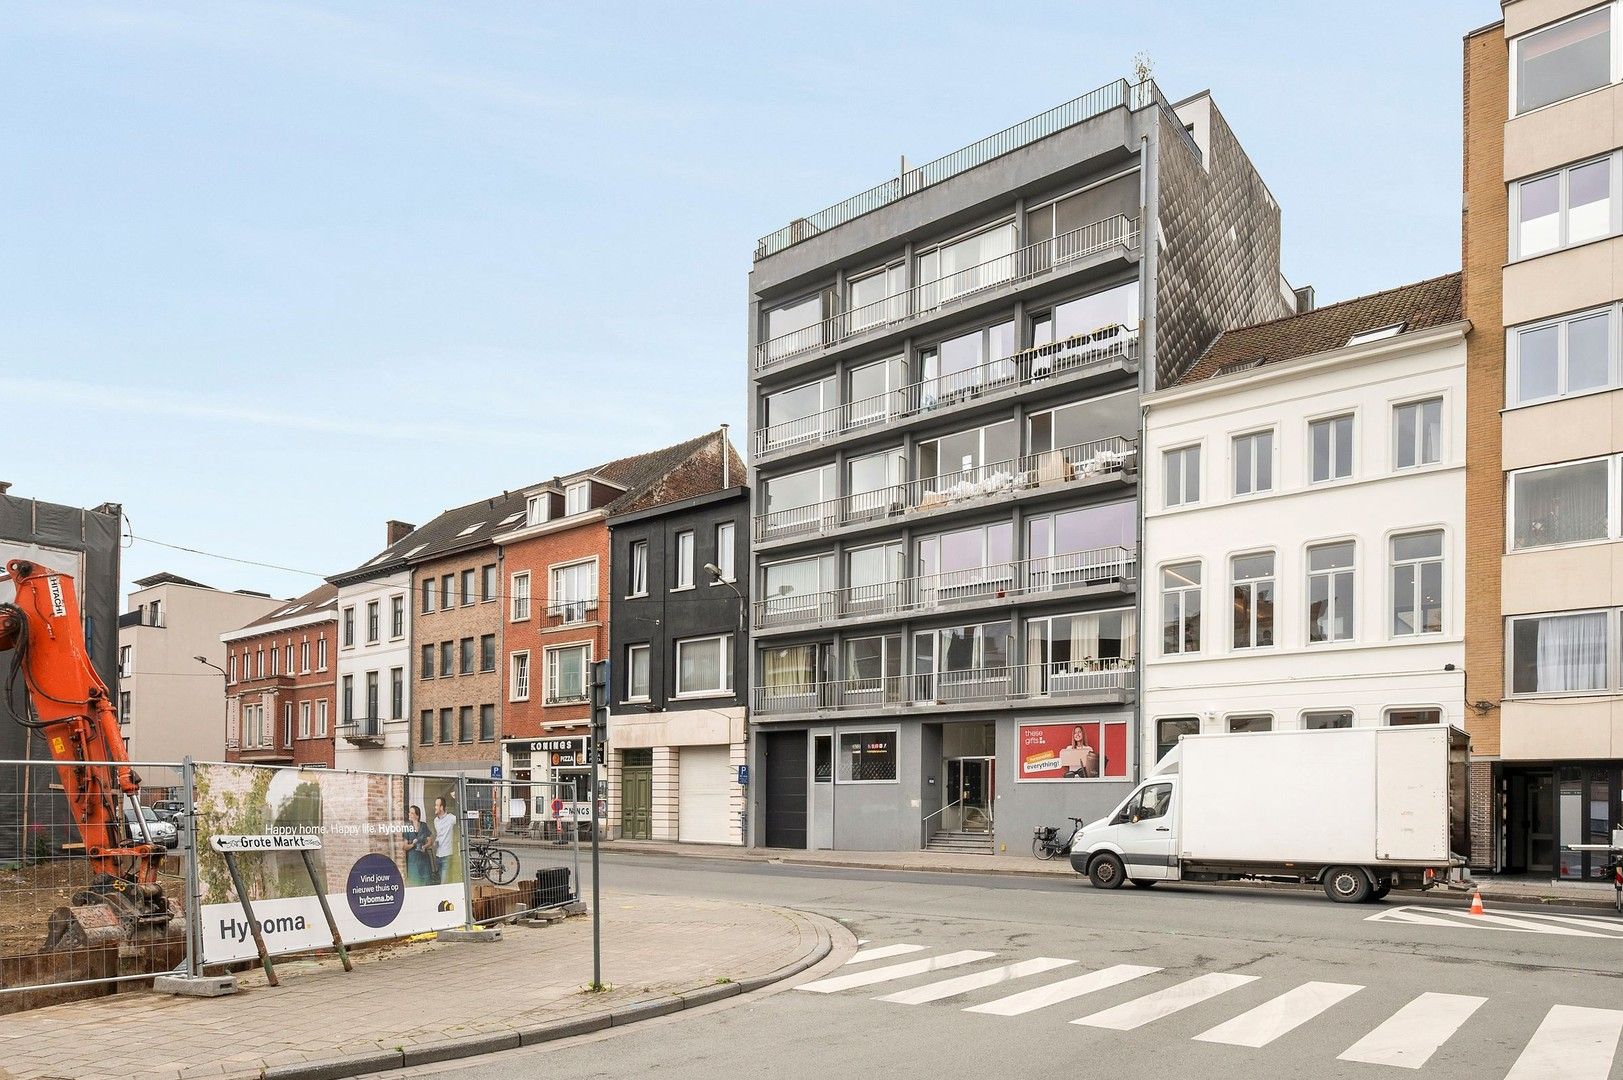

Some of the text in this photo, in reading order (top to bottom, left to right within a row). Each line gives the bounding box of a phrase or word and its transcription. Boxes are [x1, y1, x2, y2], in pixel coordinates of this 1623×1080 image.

[50, 578, 63, 615] HITACHI
[530, 741, 572, 752] KONINGS
[560, 755, 574, 763] PIZZA
[265, 824, 297, 836] Happy
[330, 823, 359, 836] Happy
[378, 823, 417, 836] Hyboma.
[240, 836, 306, 848] Grote Markt
[360, 874, 390, 883] Vind jouw
[352, 883, 399, 894] nieuwe thuis op
[359, 893, 395, 906] hyboma.be
